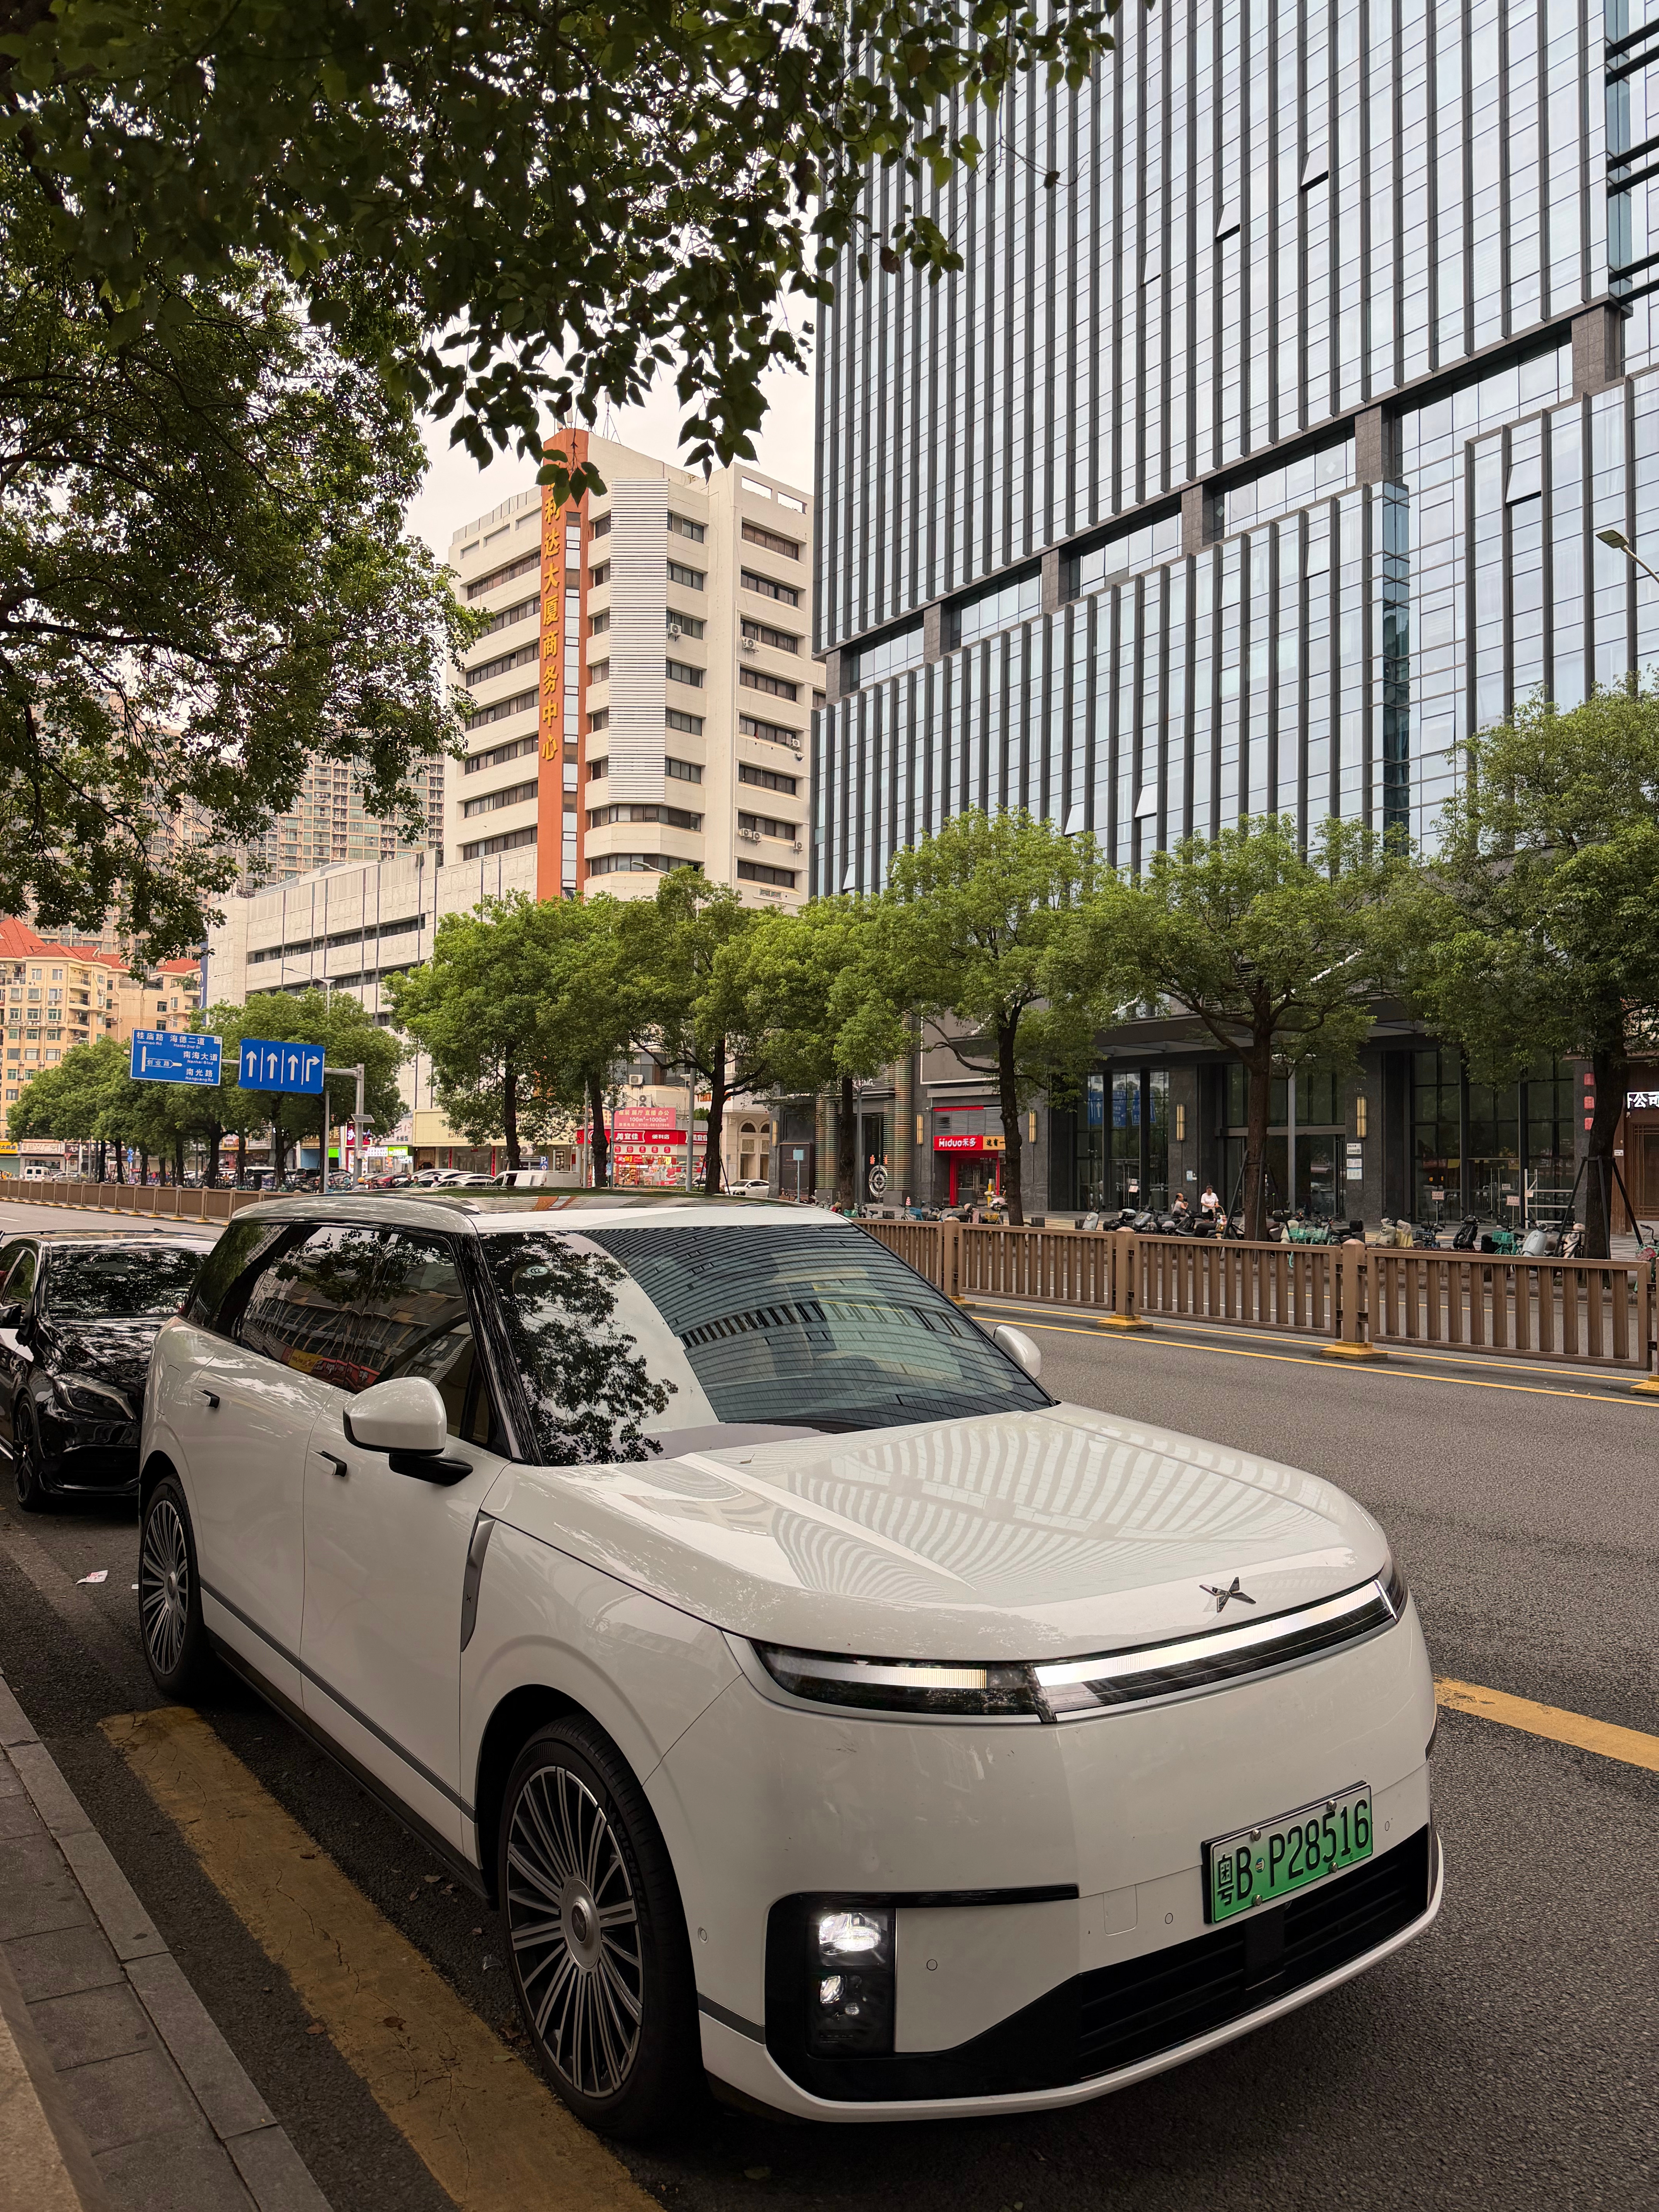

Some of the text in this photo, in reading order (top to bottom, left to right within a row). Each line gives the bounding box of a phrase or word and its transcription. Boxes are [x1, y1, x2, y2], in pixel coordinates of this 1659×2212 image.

[541, 463, 560, 761] 利达大厦商务中心
[137, 1031, 163, 1041] 桂庙路
[170, 1035, 205, 1045] 海德二道
[183, 1051, 218, 1061] 南海大道
[186, 1068, 213, 1077] 南光路
